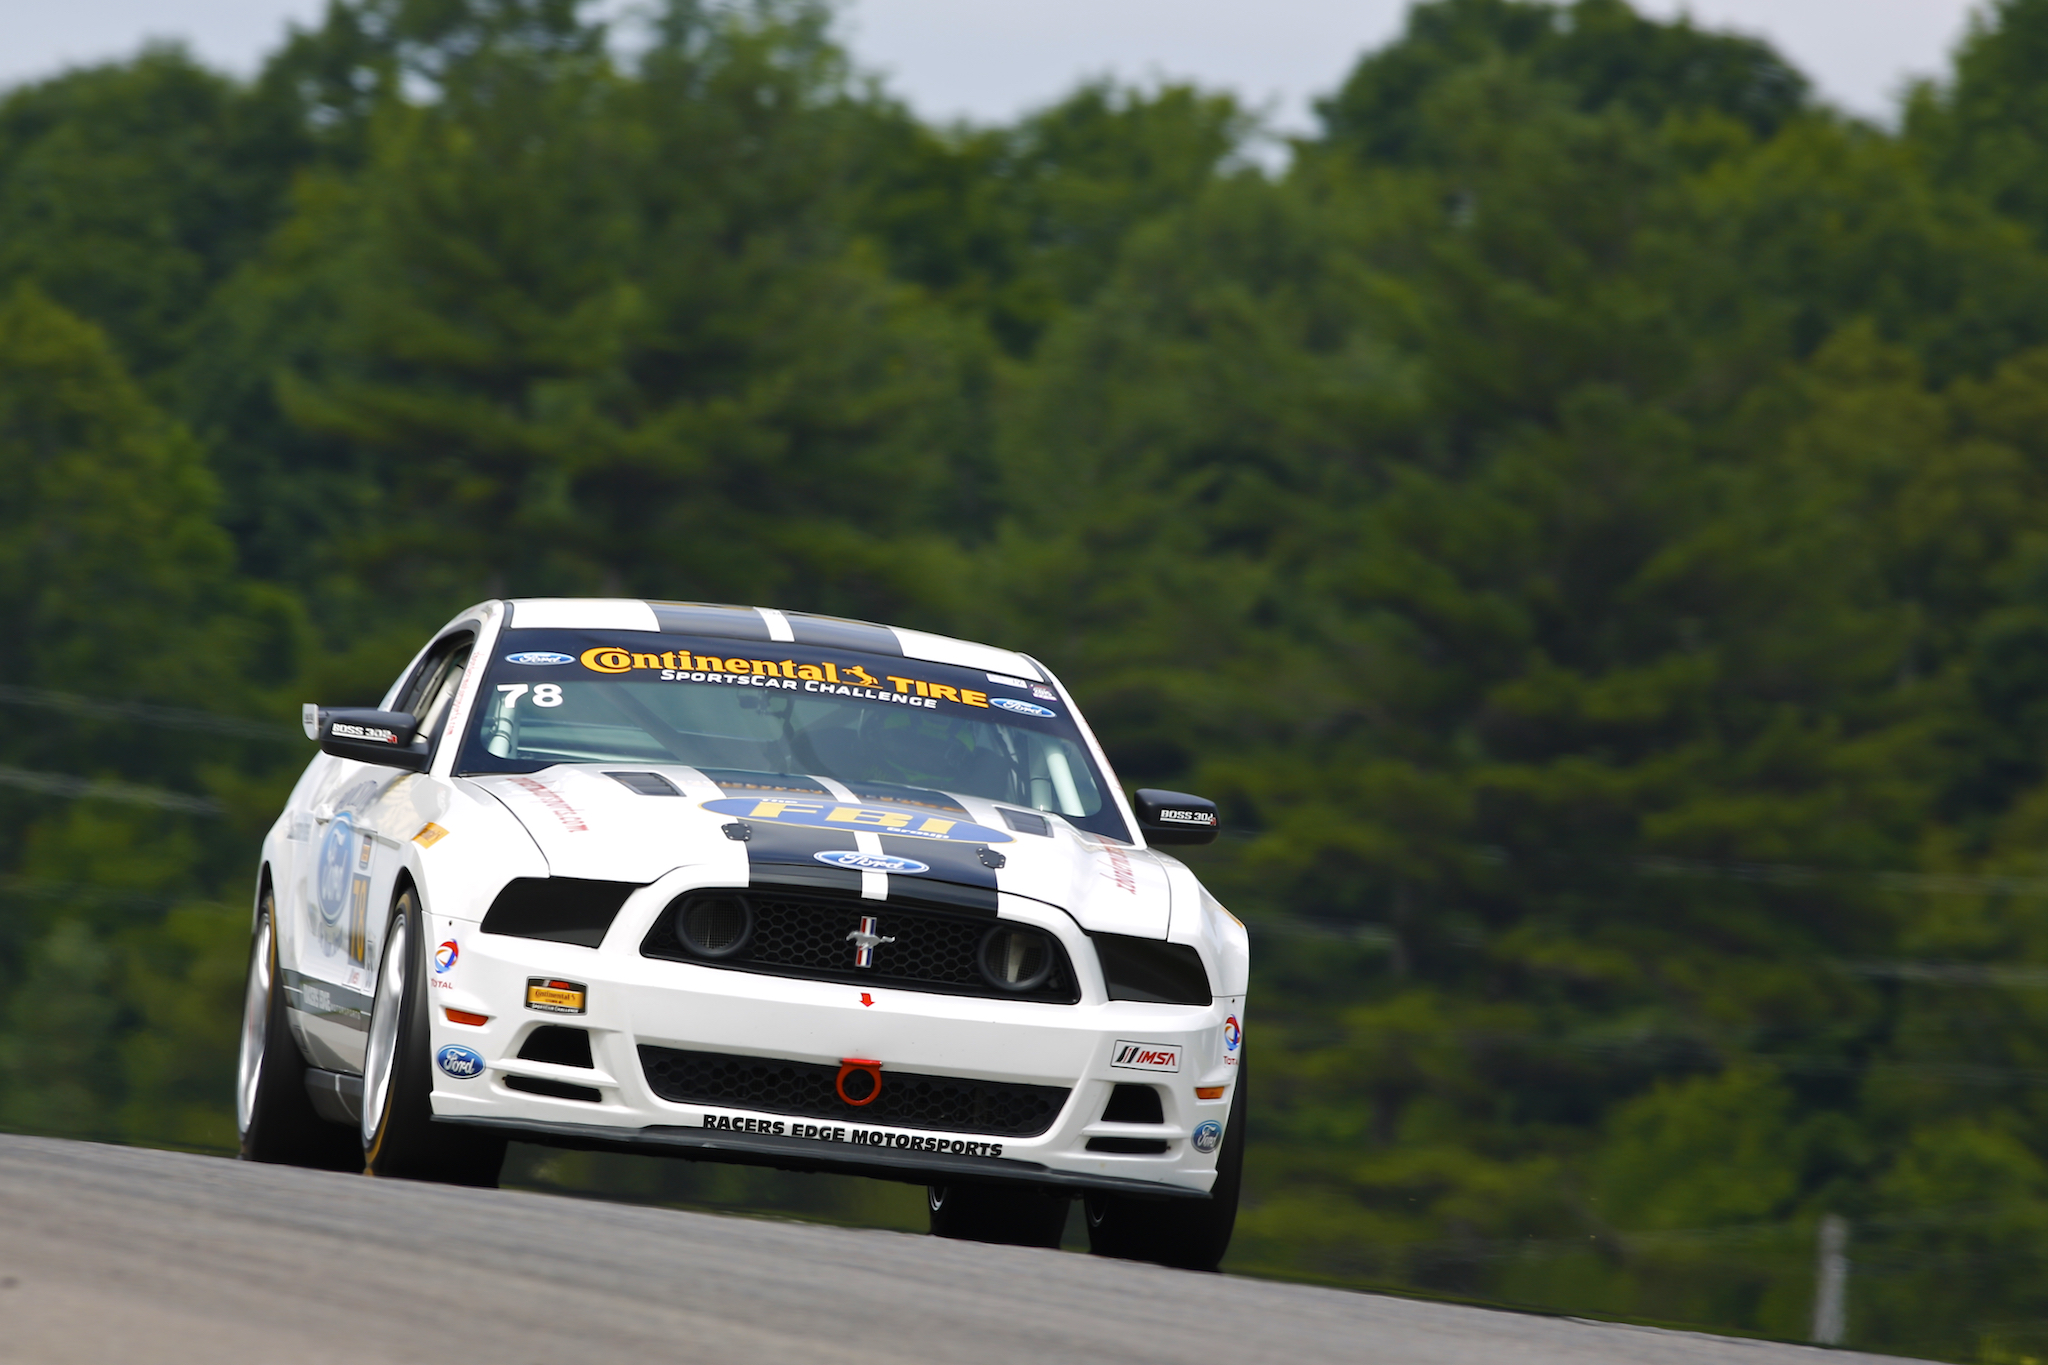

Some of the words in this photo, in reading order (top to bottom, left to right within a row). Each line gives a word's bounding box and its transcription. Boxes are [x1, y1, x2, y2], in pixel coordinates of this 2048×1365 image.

[581, 647, 841, 683] Continental
[887, 676, 989, 708] TIRE
[496, 684, 564, 708] 78
[332, 723, 364, 736] BOSS
[749, 801, 957, 834] FBI
[1161, 809, 1193, 820] BOSS
[431, 978, 453, 990] TOTAL
[444, 1049, 475, 1074] Ford
[1136, 1050, 1176, 1066] IMSA
[703, 1114, 785, 1136] RACERS
[791, 1123, 846, 1141] EDGE
[851, 1129, 1003, 1157] MOTORSPORTS
[1197, 1125, 1219, 1147] Ford
